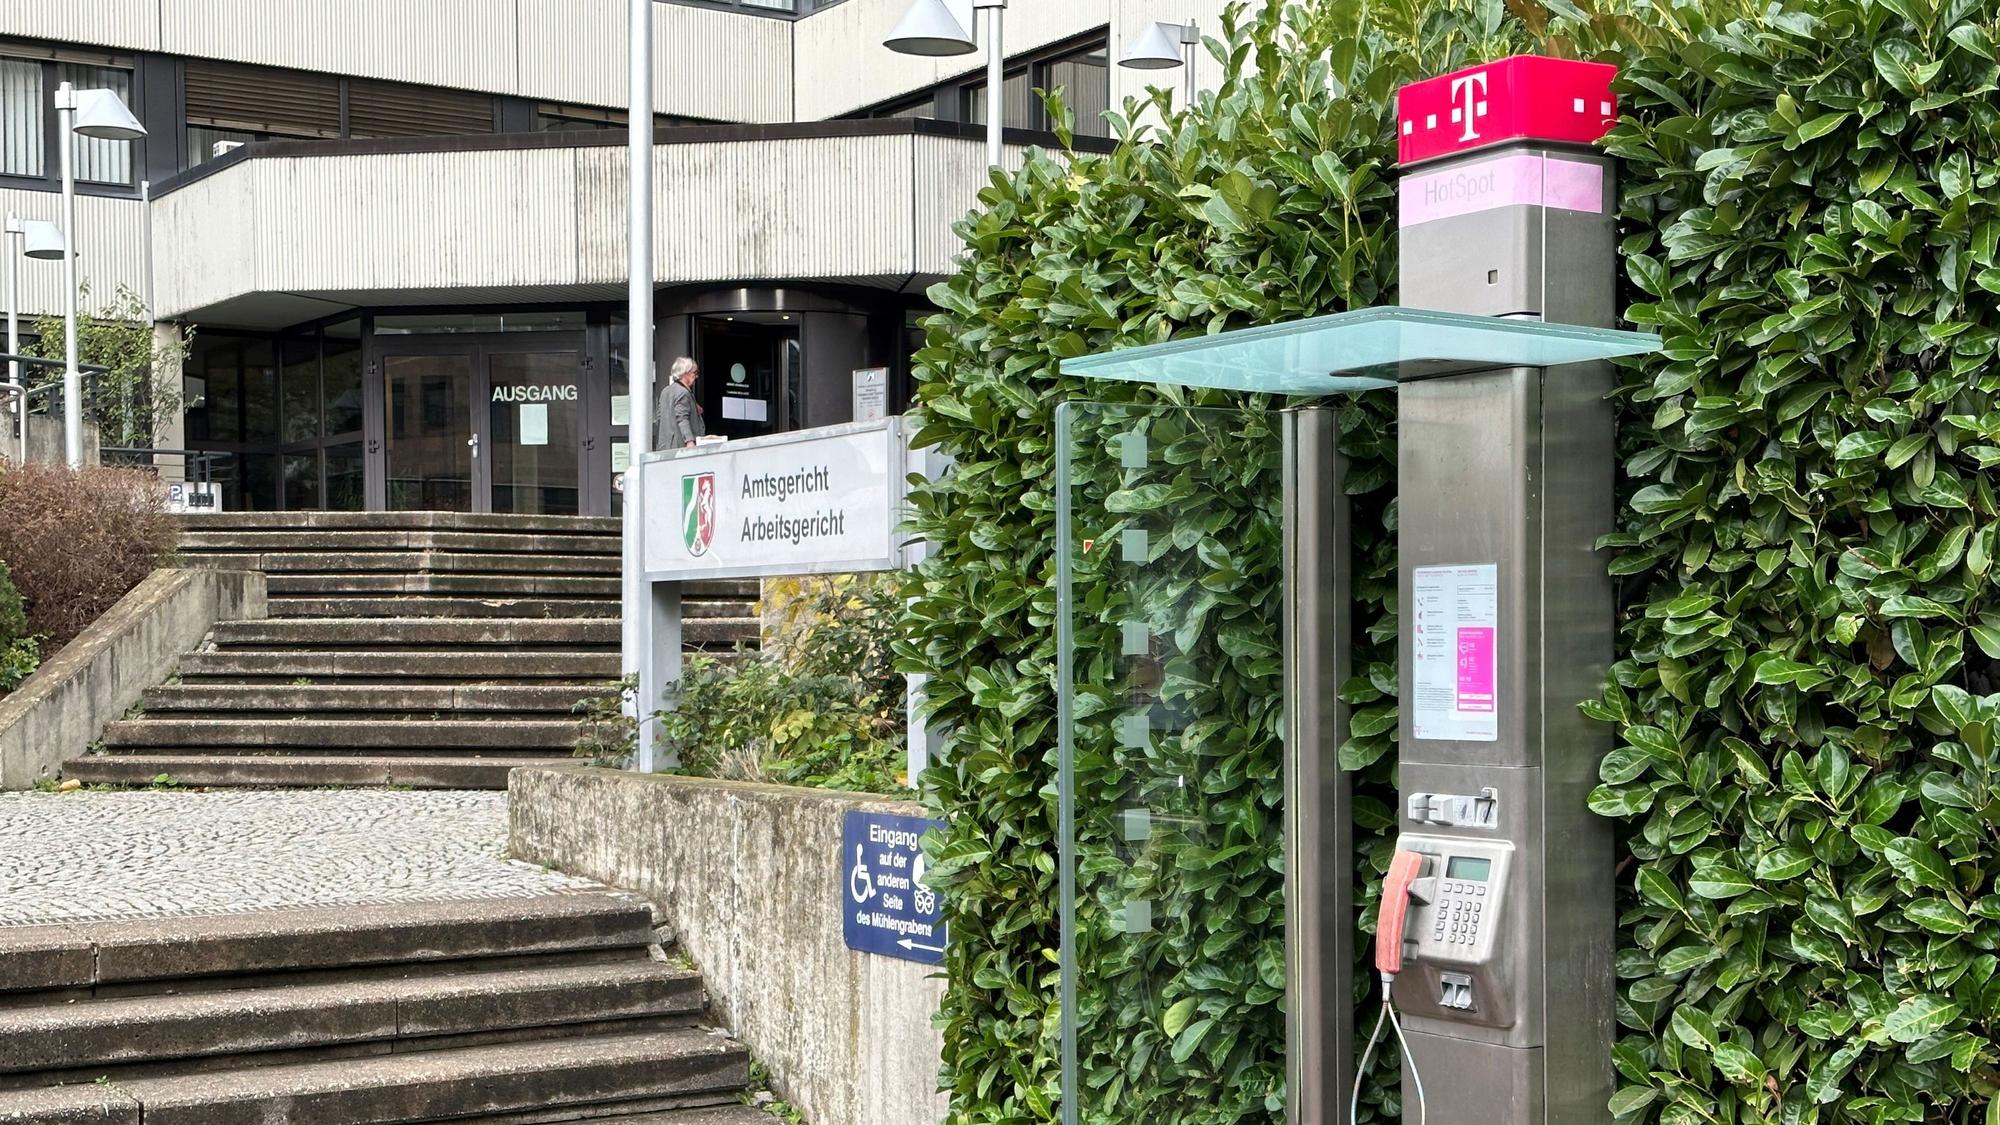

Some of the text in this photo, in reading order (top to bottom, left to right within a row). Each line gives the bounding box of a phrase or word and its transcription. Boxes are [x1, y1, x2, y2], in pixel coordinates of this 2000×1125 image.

[1451, 71, 1487, 142] T
[1424, 169, 1496, 206] HotSpot
[492, 384, 578, 402] AUSGANG
[741, 465, 829, 502] Amtsgericht
[741, 508, 844, 545] Arbeitsgericht
[869, 824, 918, 851] Eingang
[879, 852, 907, 868] auf der
[877, 874, 910, 890] anderen
[883, 893, 903, 910] Seite
[856, 910, 932, 937] des Mühlengrabens
